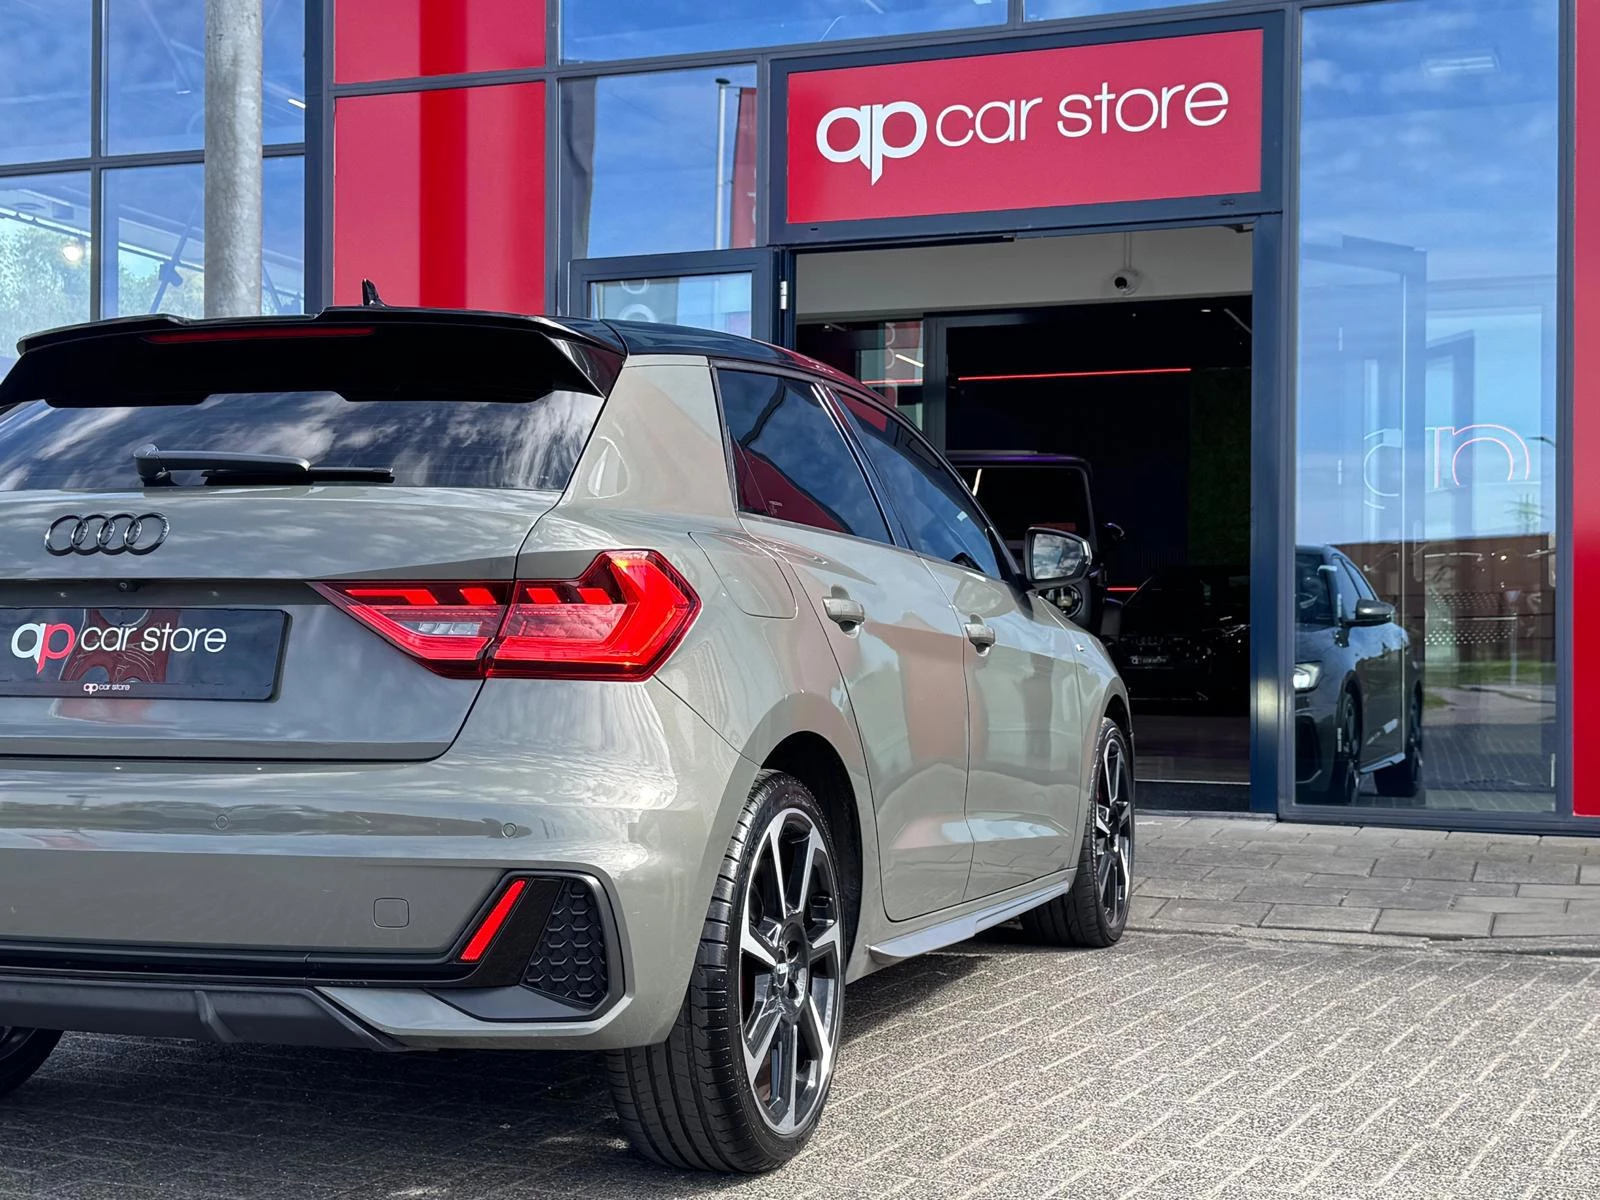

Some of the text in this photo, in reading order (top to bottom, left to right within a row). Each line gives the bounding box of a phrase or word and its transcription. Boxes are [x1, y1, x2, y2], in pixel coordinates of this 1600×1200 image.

[816, 81, 1229, 186] ap car store
[11, 622, 227, 675] ap car store
[83, 683, 99, 695] ap
